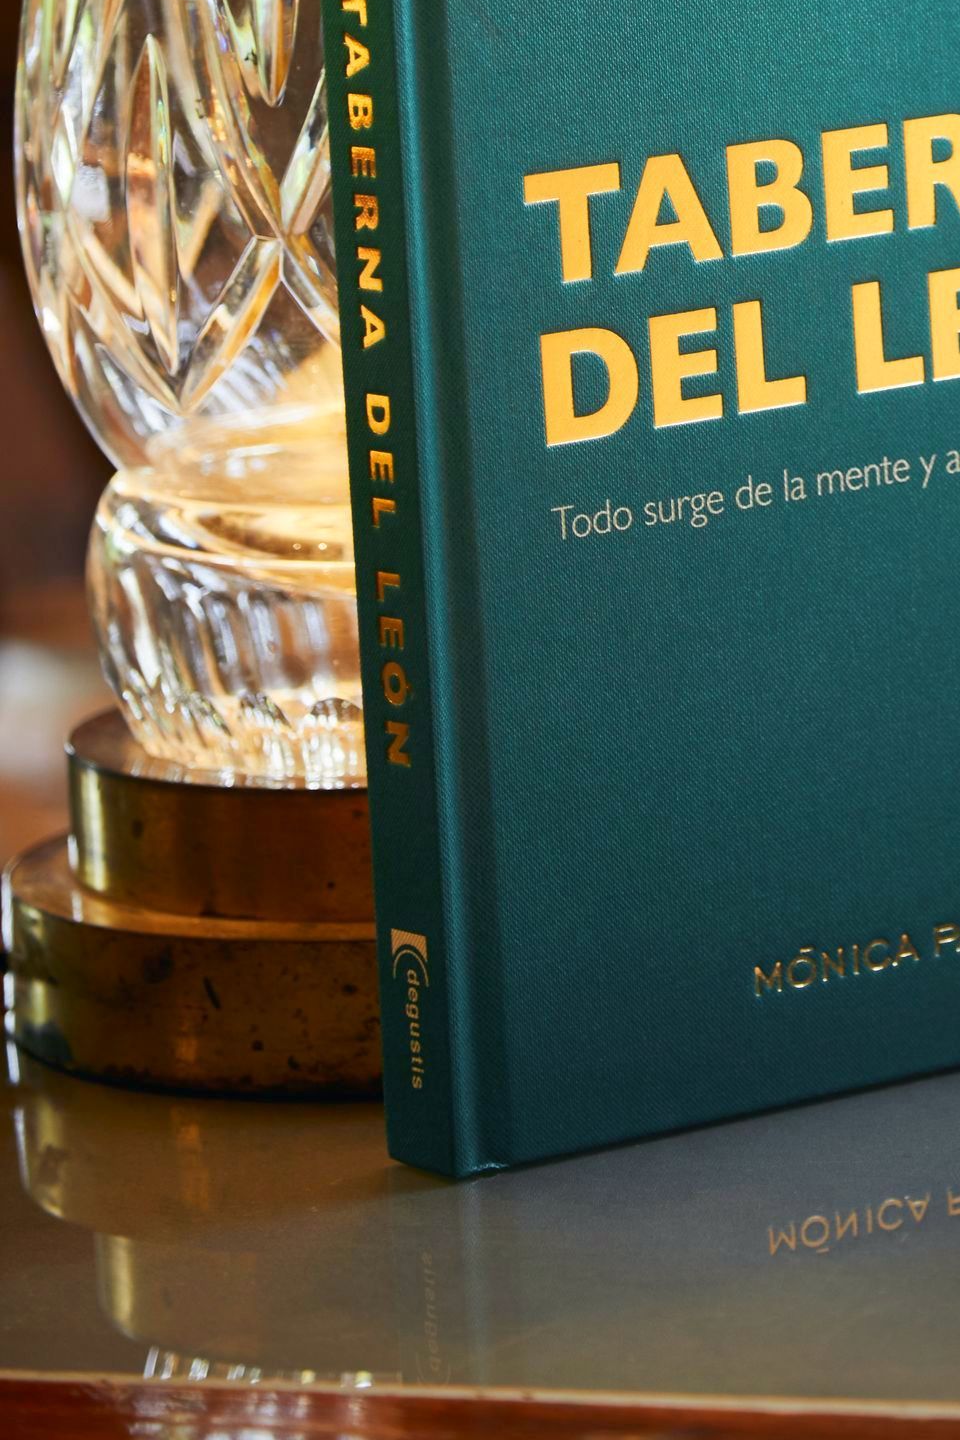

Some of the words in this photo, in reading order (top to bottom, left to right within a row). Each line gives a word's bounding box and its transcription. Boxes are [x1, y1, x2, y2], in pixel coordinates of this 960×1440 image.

[540, 300, 807, 447] DEL
[366, 393, 396, 528] DEL
[551, 499, 632, 539] Todo
[644, 491, 724, 527] surge
[736, 475, 772, 509] de
[783, 469, 806, 501] la
[817, 457, 910, 495] mente
[920, 454, 937, 488] y
[376, 571, 414, 768] LEÓN
[405, 968, 425, 1090] degustis
